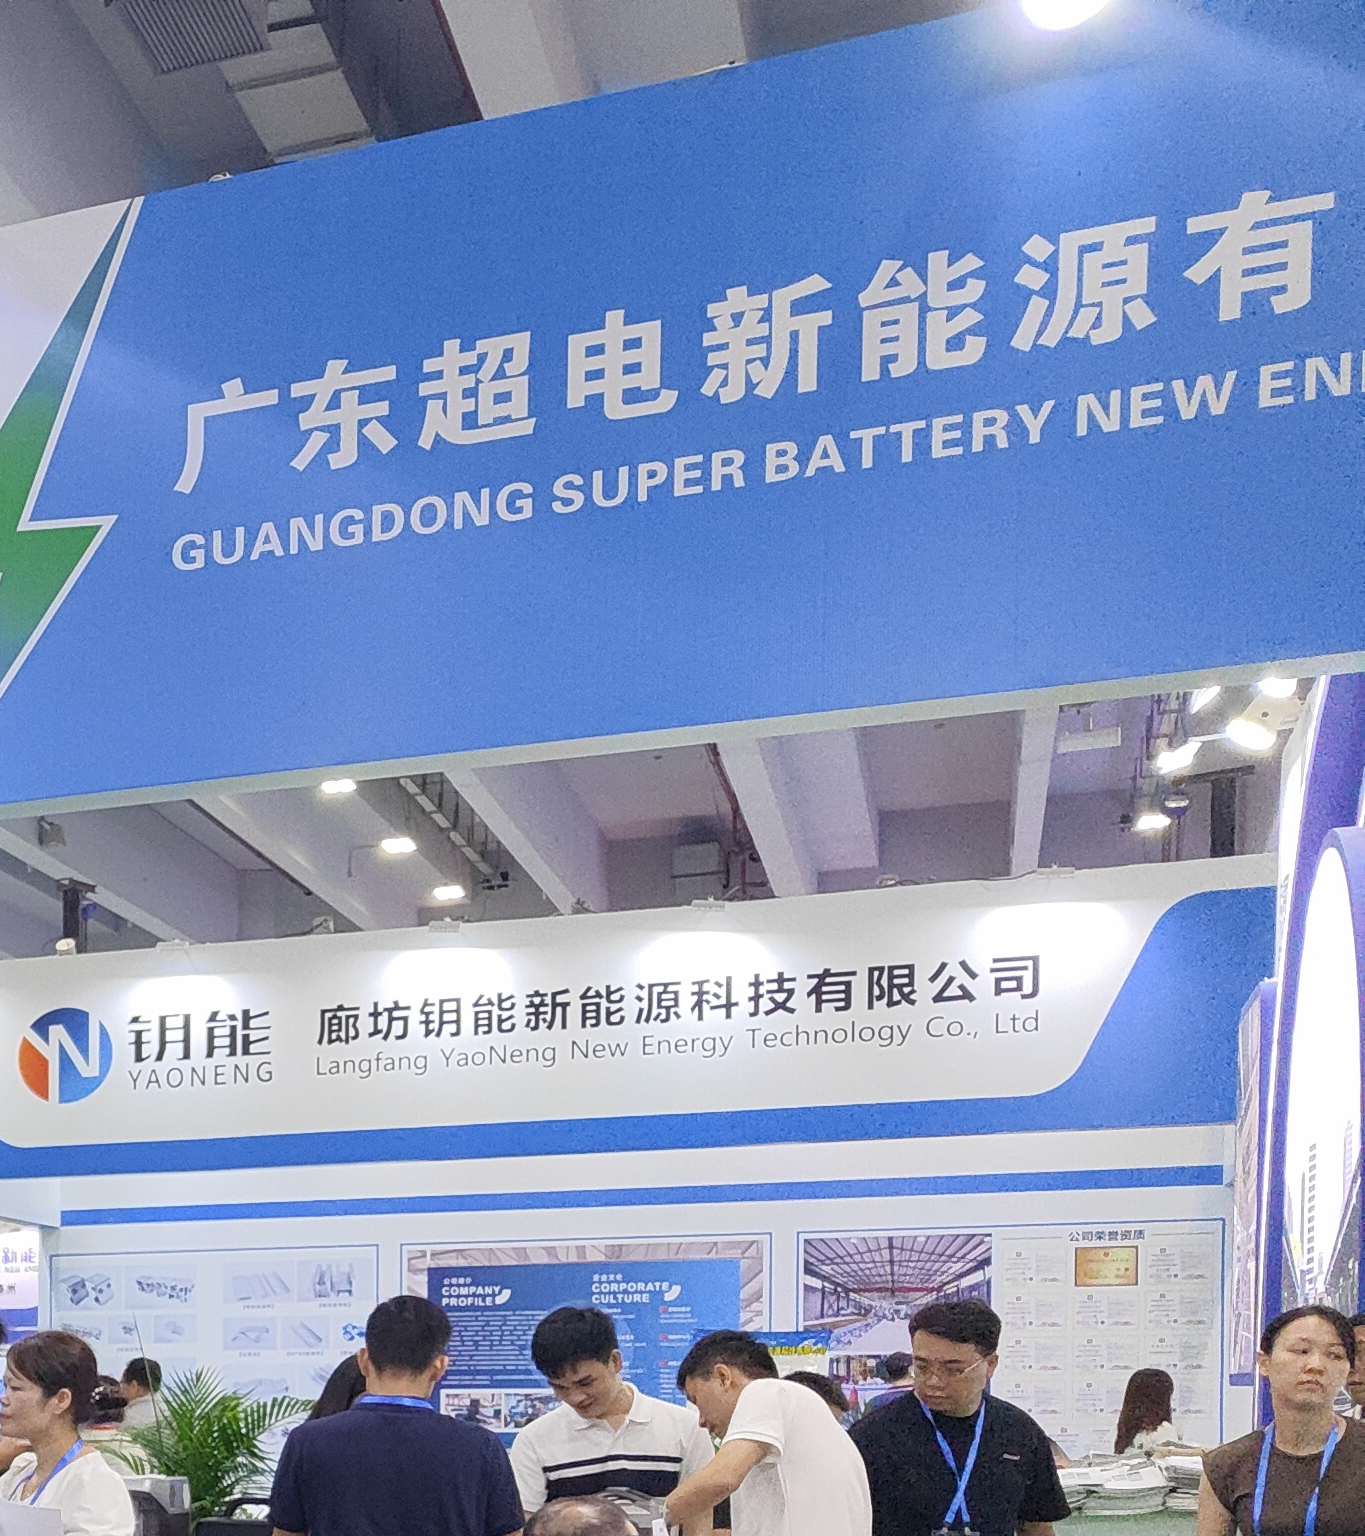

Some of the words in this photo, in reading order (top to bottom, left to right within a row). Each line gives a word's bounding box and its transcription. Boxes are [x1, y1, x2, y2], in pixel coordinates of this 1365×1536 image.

[171, 188, 1337, 496] 广东超电新能源有
[171, 482, 534, 571] GUANGDONG
[550, 447, 747, 515] SUPER
[764, 399, 1056, 484] BATTERY
[1075, 369, 1239, 438] NEW
[1257, 348, 1365, 409] EN
[317, 954, 1041, 1048] 廊坊钥能新能源科技有限公司
[127, 1007, 272, 1064] 钥能
[315, 1051, 428, 1080] Langfang
[440, 1044, 557, 1069] YaoNeng
[570, 1039, 629, 1060] New
[641, 1033, 735, 1058] Energy
[745, 1021, 913, 1049] Technology
[925, 1016, 979, 1041] Co.,
[994, 1009, 1040, 1035] Ltd
[127, 1061, 274, 1091] YAONENG
[441, 1284, 500, 1296] COMPANY
[441, 1296, 494, 1307] PROFILE
[591, 1281, 670, 1293] CORPORATE
[591, 1292, 650, 1304] CULTURE
